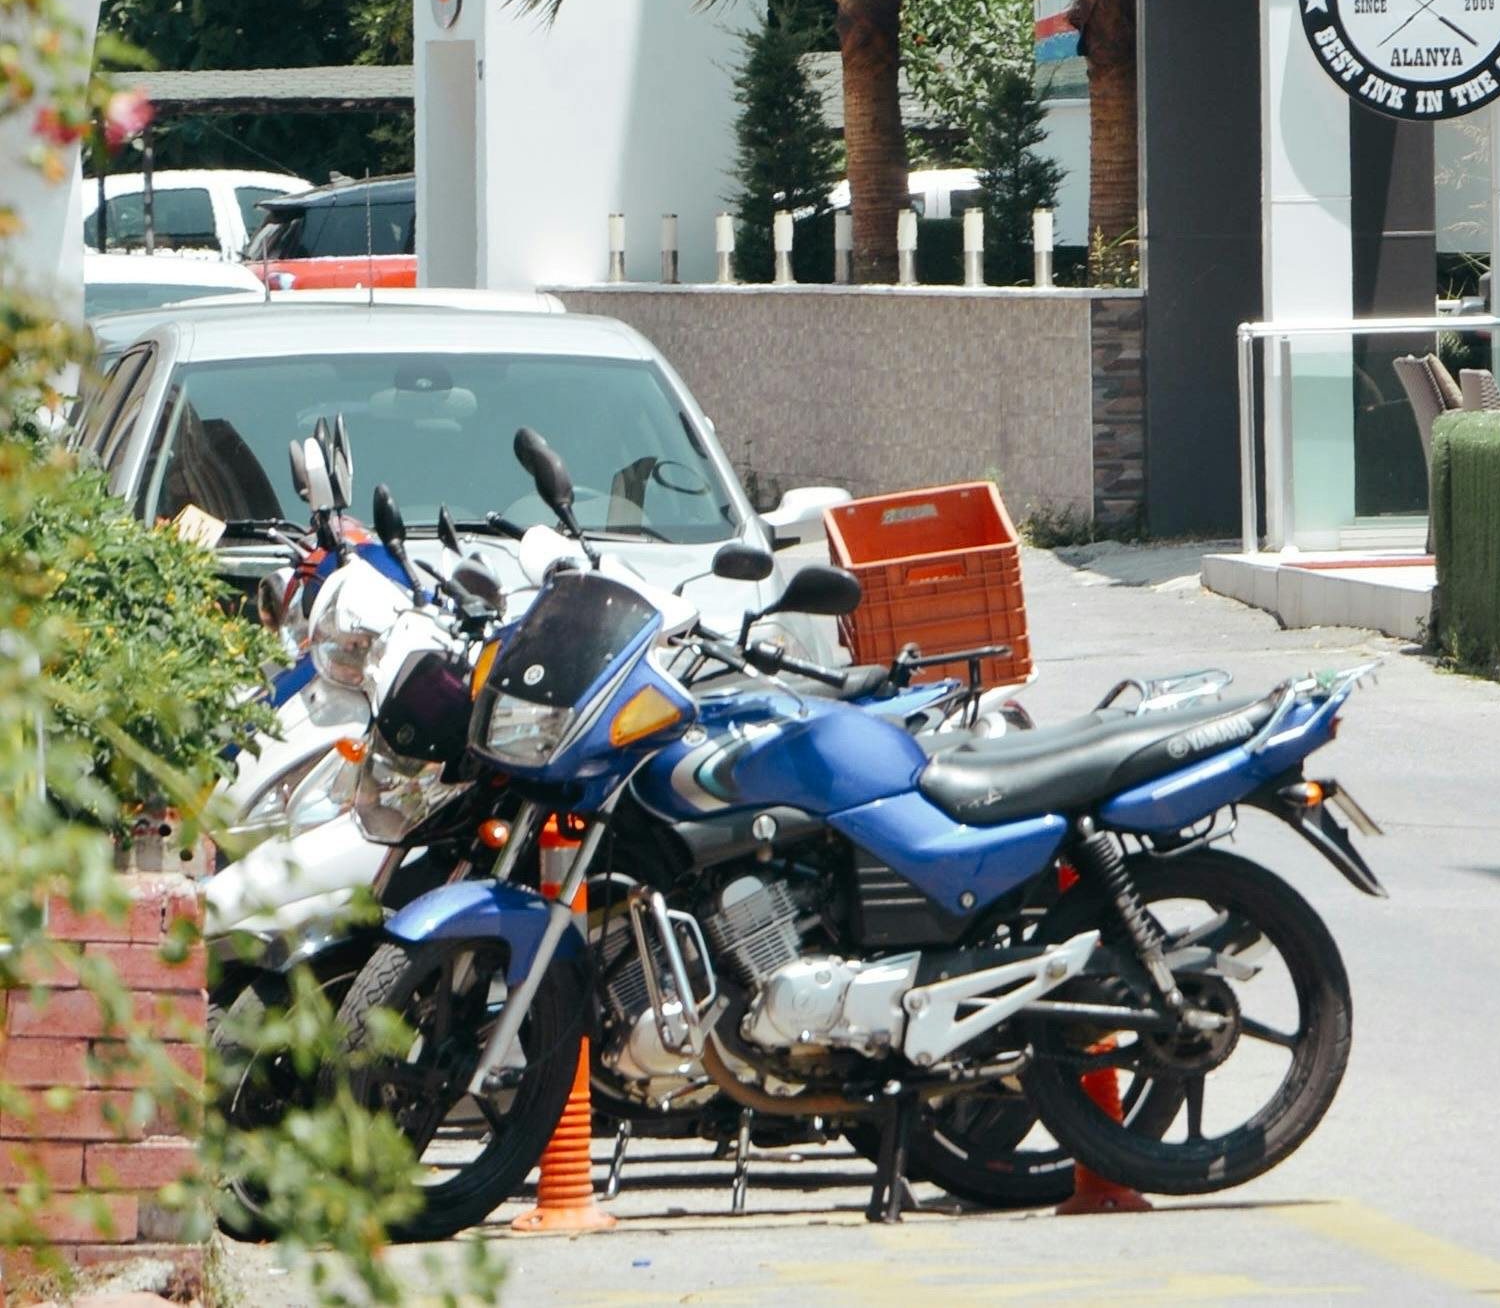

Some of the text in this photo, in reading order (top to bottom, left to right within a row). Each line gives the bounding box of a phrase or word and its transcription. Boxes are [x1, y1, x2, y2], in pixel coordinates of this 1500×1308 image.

[1314, 25, 1364, 82] BEST
[1359, 74, 1407, 110] INK
[1415, 89, 1443, 113] IN
[1450, 70, 1499, 108] THE
[1390, 47, 1463, 67] ALANYA
[1185, 716, 1254, 751] YAMAHA
